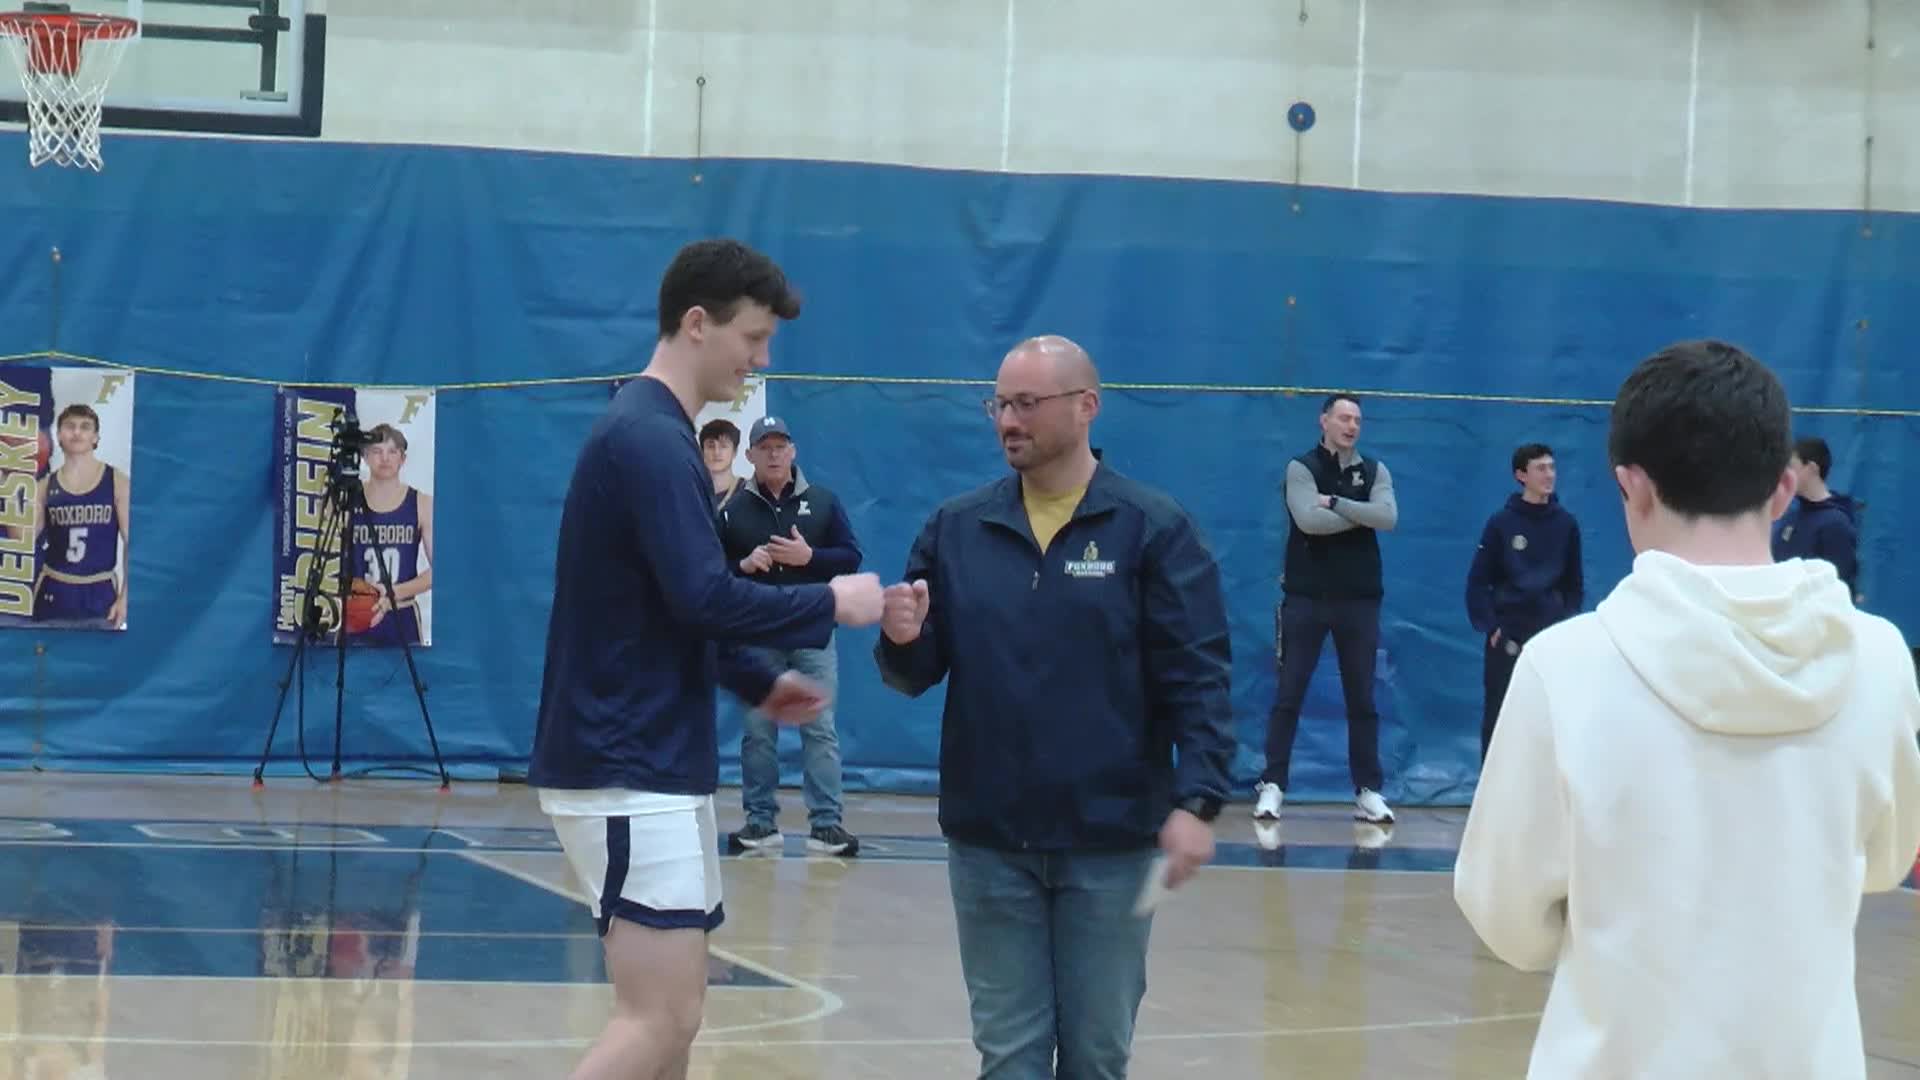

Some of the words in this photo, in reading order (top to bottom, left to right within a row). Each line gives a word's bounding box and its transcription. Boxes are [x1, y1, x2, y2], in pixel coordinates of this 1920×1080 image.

[95, 375, 124, 402] F
[401, 394, 428, 423] F
[48, 505, 113, 525] FOXBORO
[66, 527, 89, 563] 5
[363, 547, 402, 584] 30
[277, 574, 295, 632] Henry
